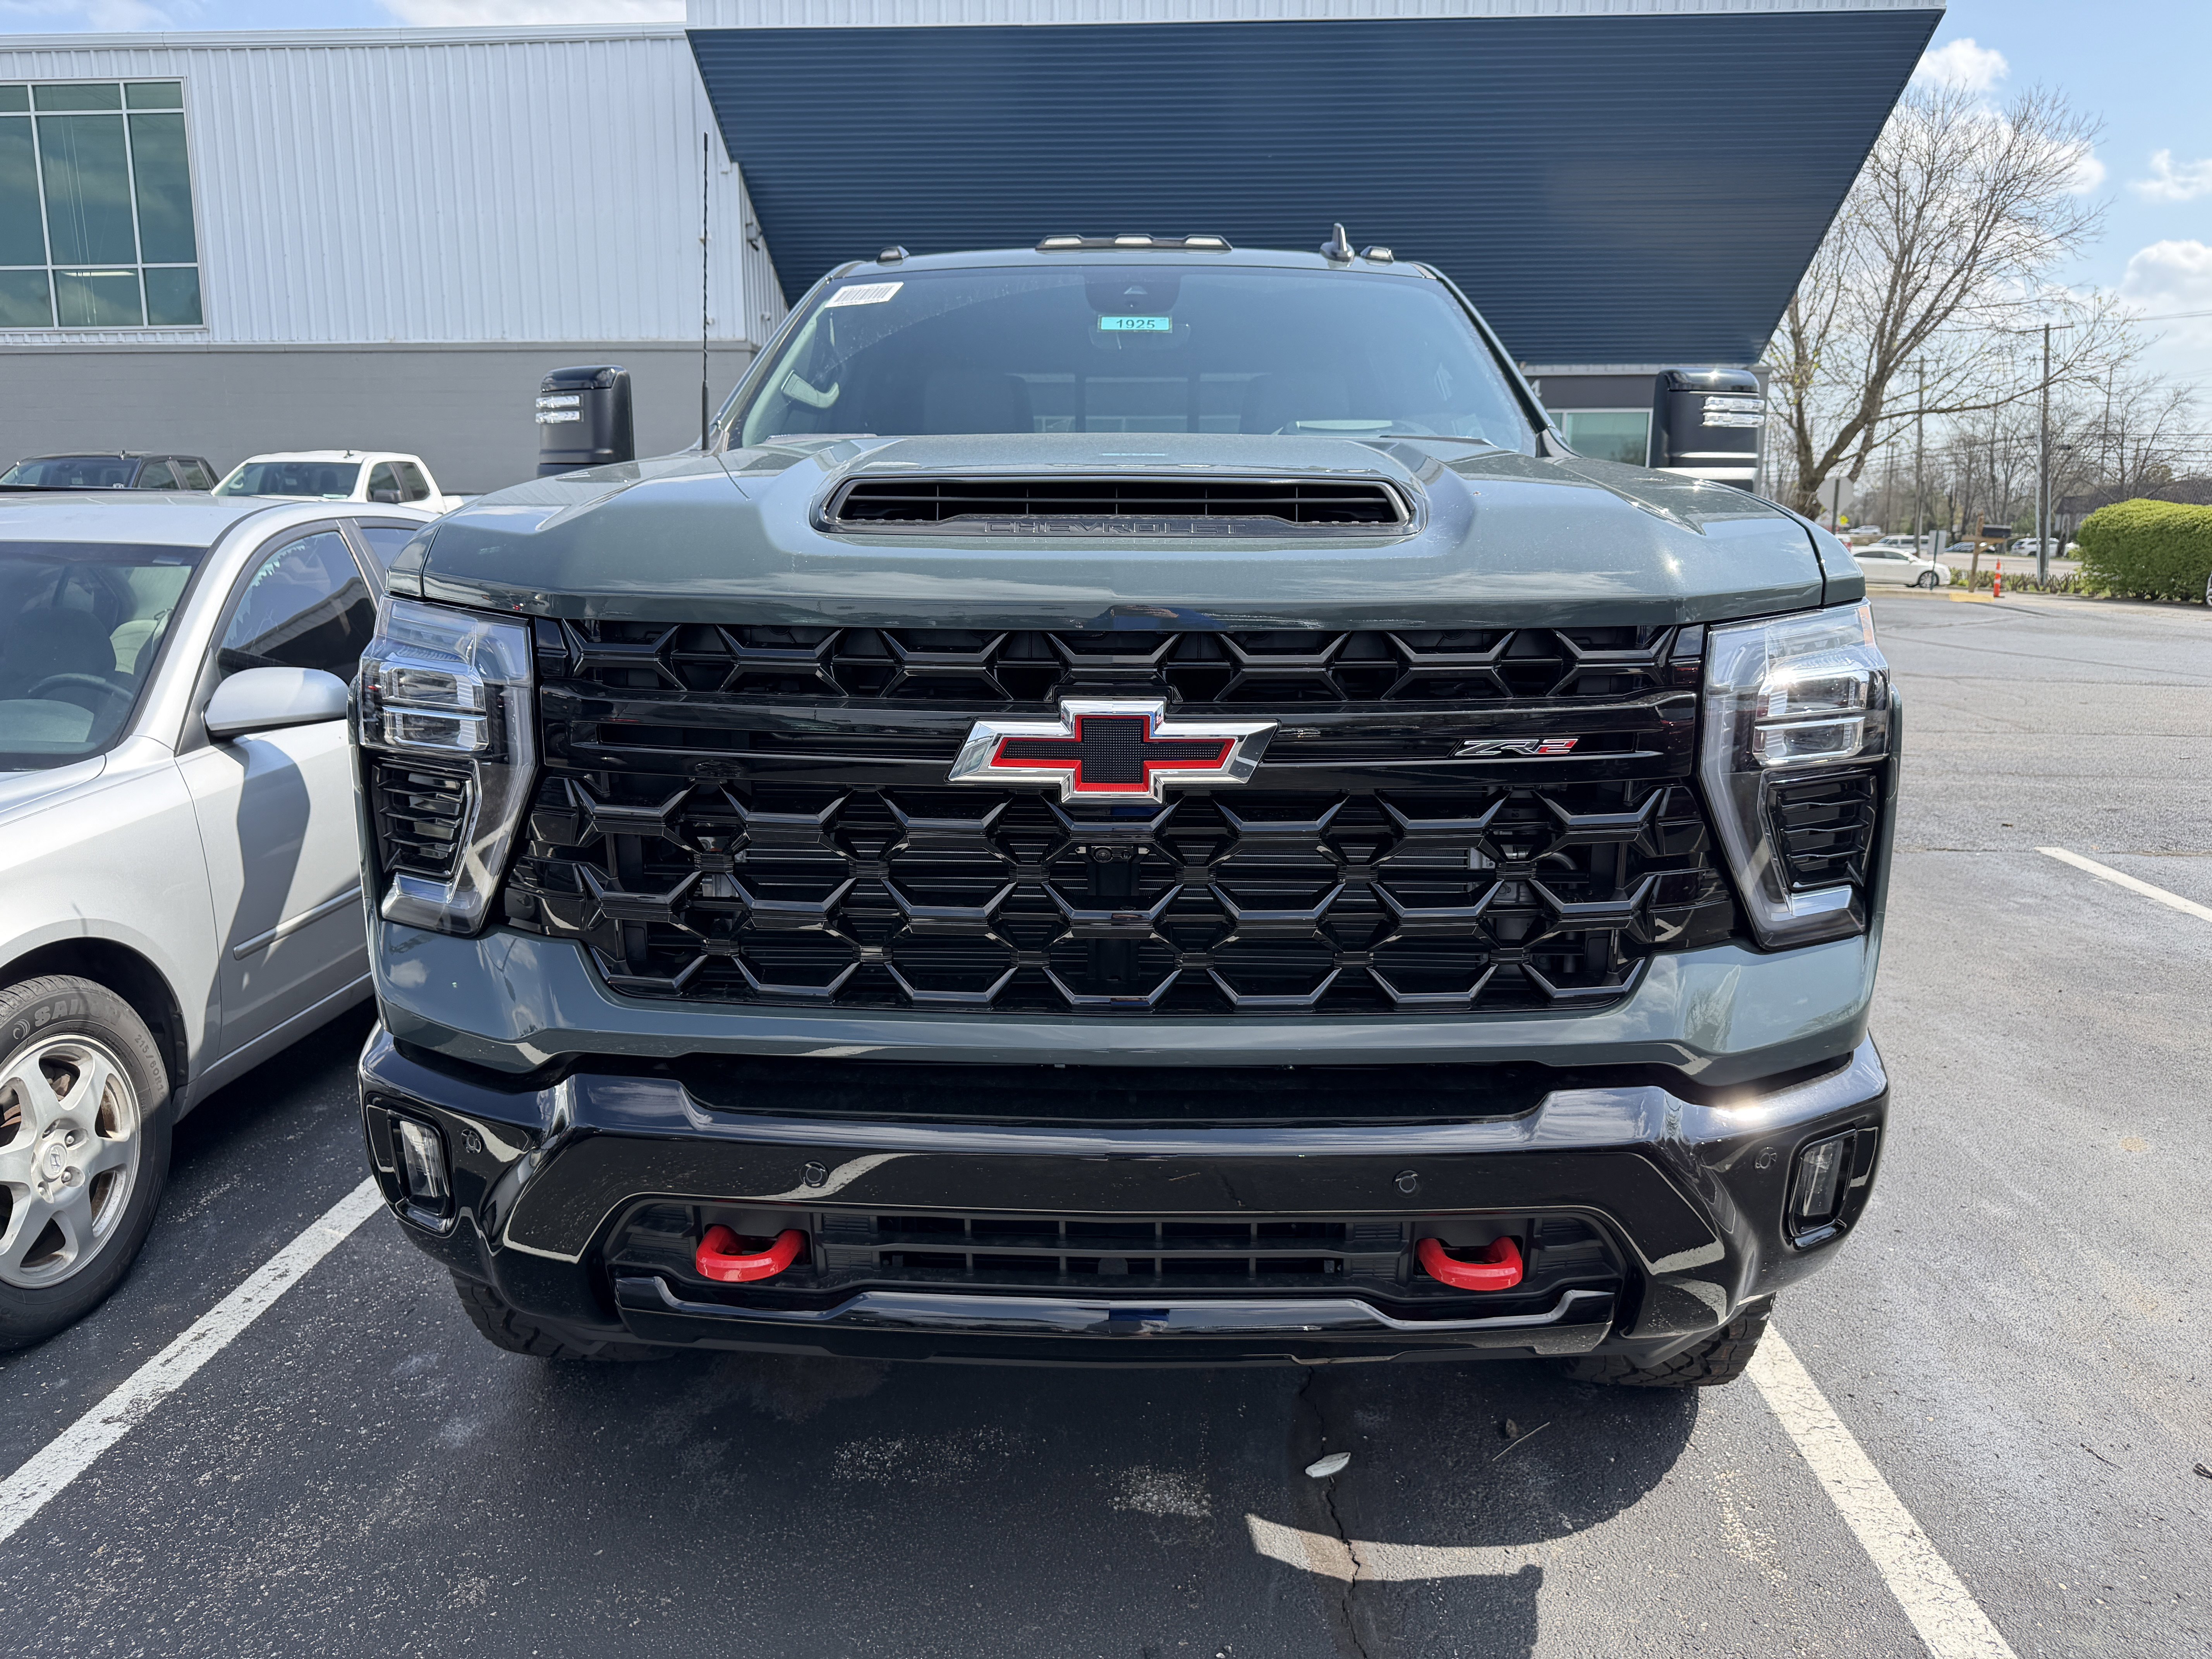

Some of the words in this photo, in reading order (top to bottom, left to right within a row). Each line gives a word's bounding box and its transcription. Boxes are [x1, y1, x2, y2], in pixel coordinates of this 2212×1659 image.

[1116, 319, 1155, 329] 1925
[985, 521, 1246, 534] CHEVROLET
[1455, 738, 1579, 756] ZR2
